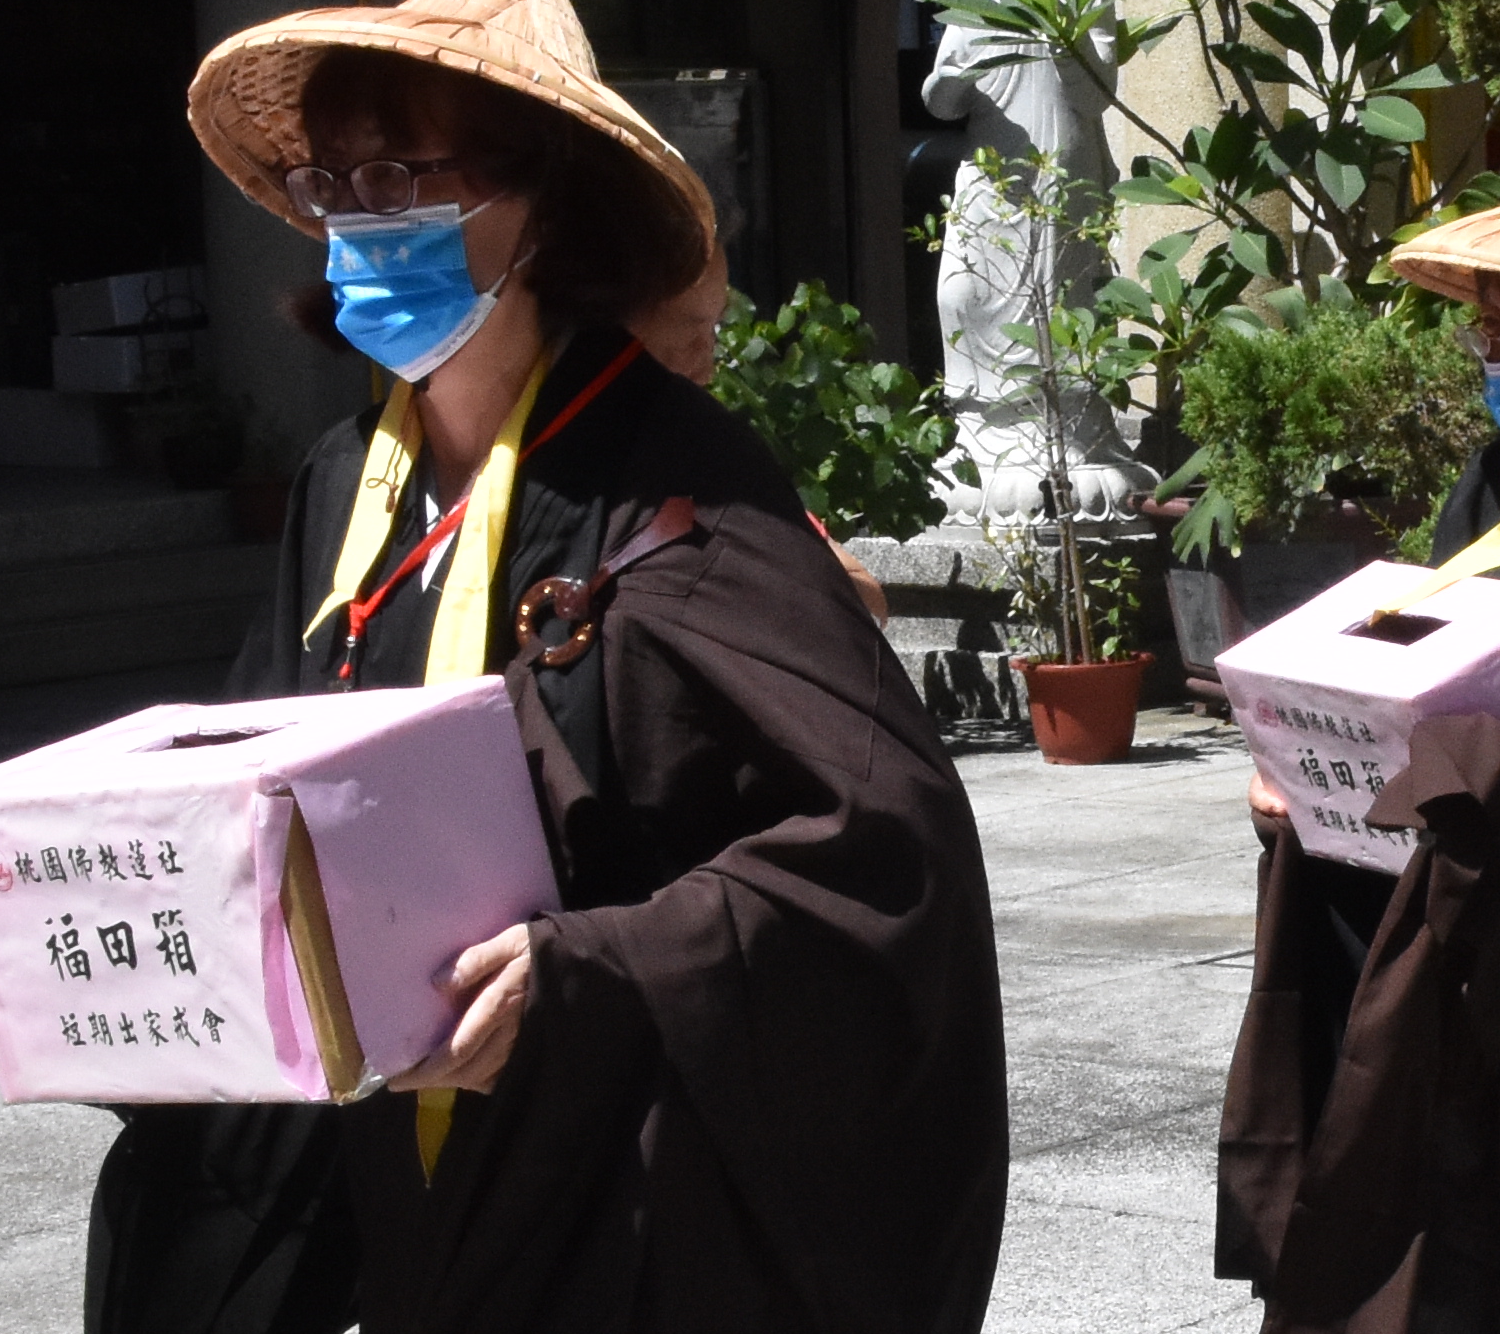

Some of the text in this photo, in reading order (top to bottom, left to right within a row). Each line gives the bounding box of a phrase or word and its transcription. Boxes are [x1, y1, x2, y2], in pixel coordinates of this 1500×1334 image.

[1296, 747, 1386, 798] 福田箱
[44, 908, 199, 982] 福田箱
